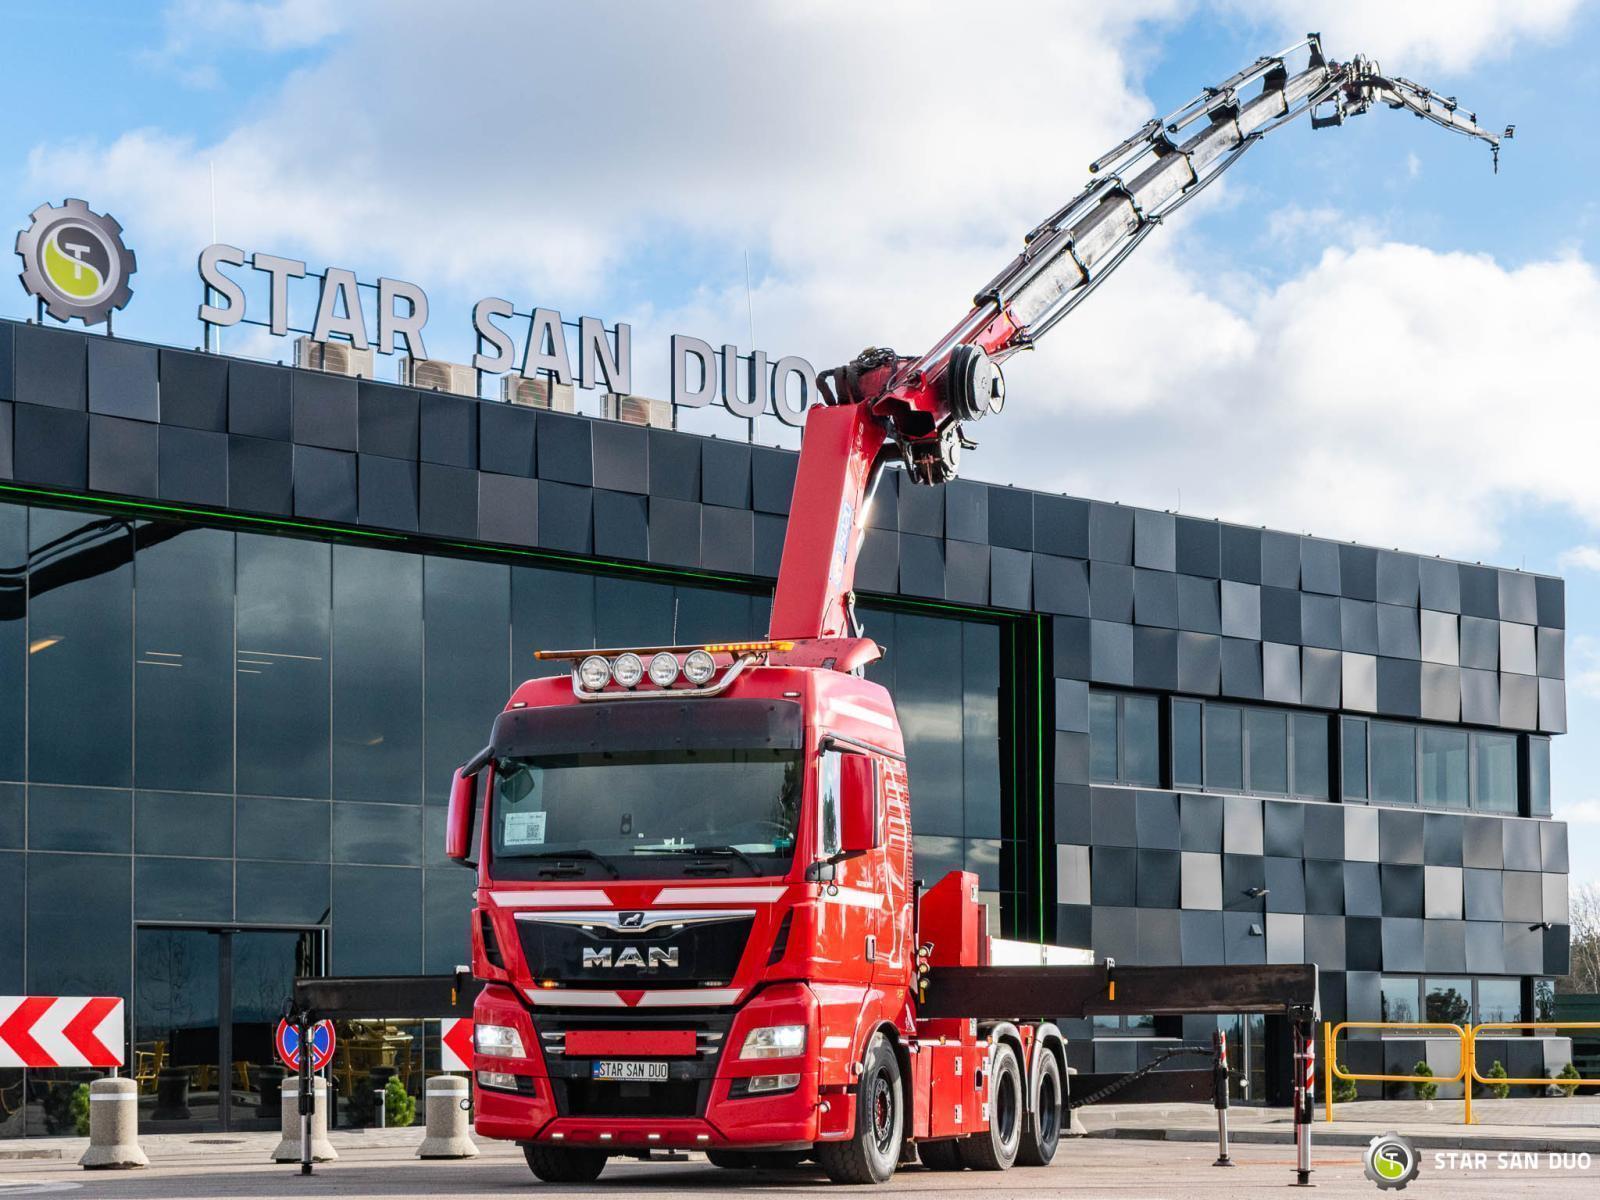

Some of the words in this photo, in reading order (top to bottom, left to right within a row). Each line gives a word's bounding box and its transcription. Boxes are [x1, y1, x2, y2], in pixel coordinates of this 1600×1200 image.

[198, 243, 429, 361] STAR
[472, 297, 632, 395] SAN
[670, 334, 818, 427] DUO
[582, 946, 679, 968] MAN
[600, 1062, 623, 1077] STAR
[626, 1062, 645, 1077] SAN
[648, 1063, 667, 1078] DUO
